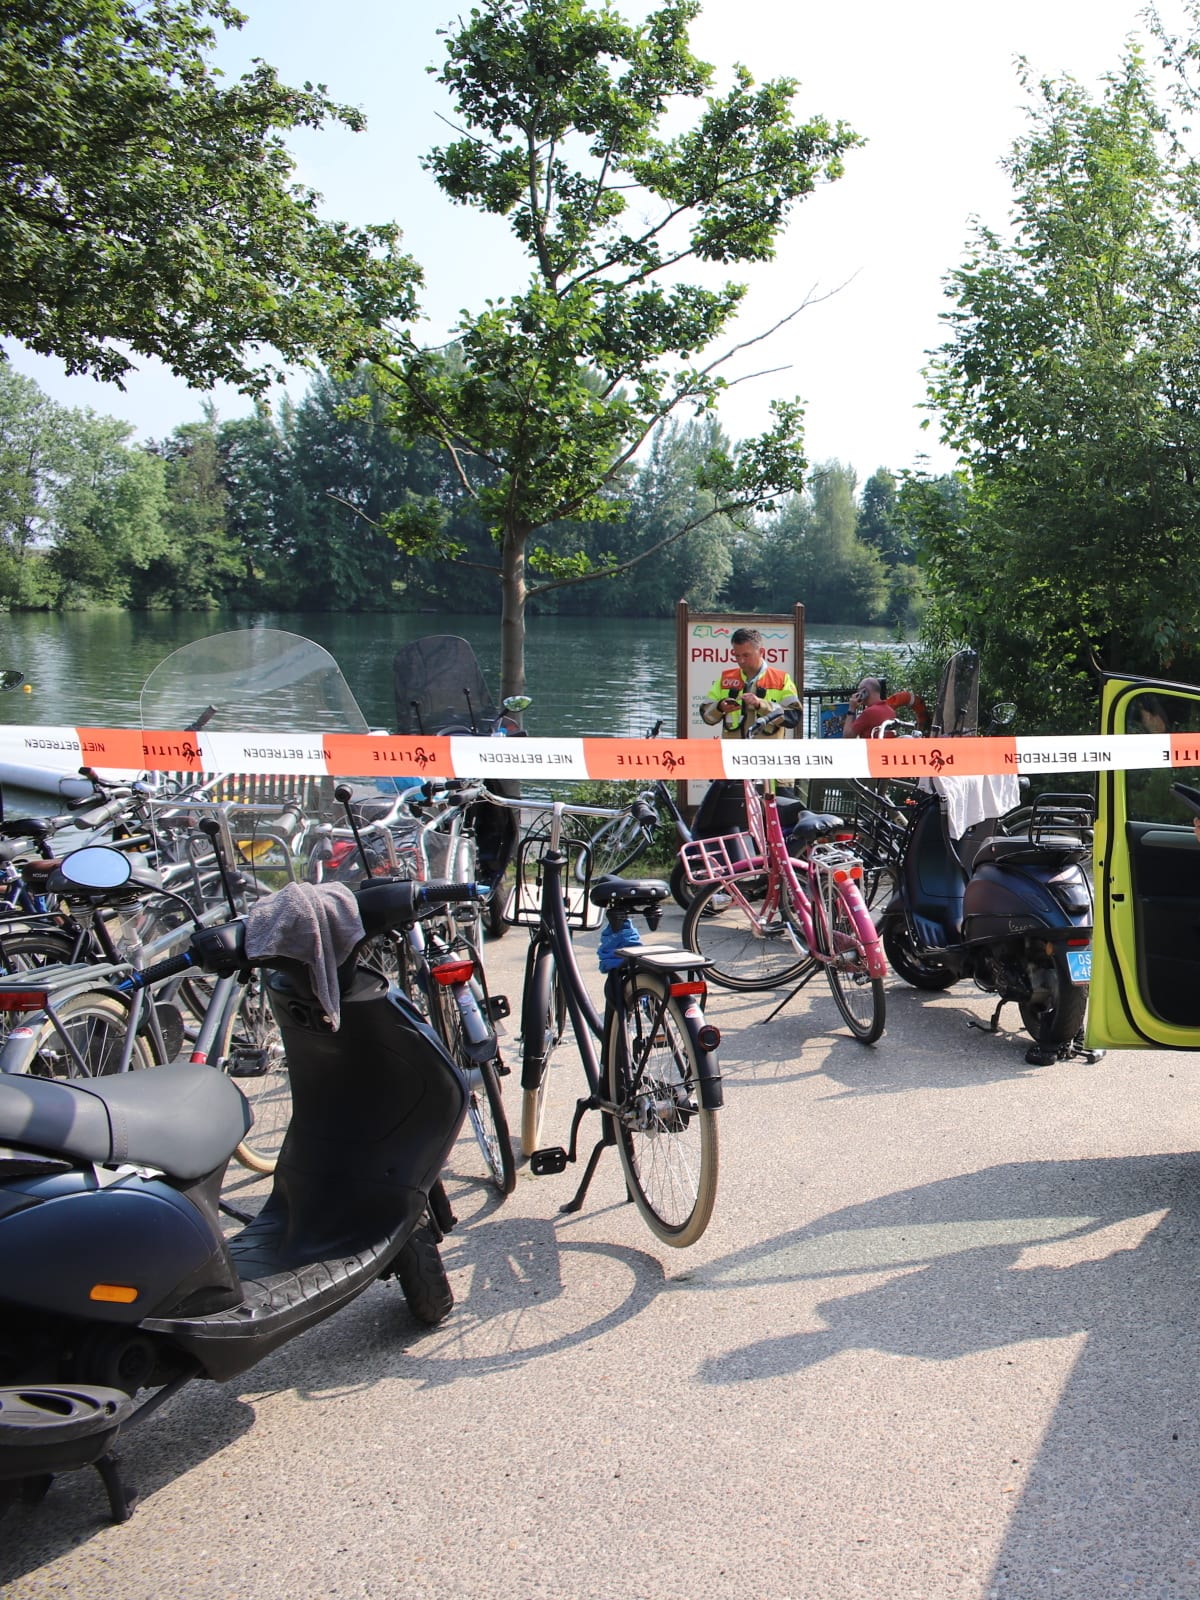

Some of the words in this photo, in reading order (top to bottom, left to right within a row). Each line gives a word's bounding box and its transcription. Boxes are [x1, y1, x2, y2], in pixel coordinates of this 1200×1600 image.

[691, 648, 789, 663] PRIJSST
[24, 738, 81, 751] BETREDEN
[82, 742, 106, 753] NIET
[243, 748, 303, 760] BETREDEN
[306, 750, 332, 761] NIET
[479, 752, 543, 763] BETREDEN
[546, 753, 573, 764] NIET
[1004, 752, 1077, 764] BETREDEN
[1081, 751, 1111, 762] NIET
[732, 755, 801, 765] BETREDEN
[804, 755, 833, 765] NIET
